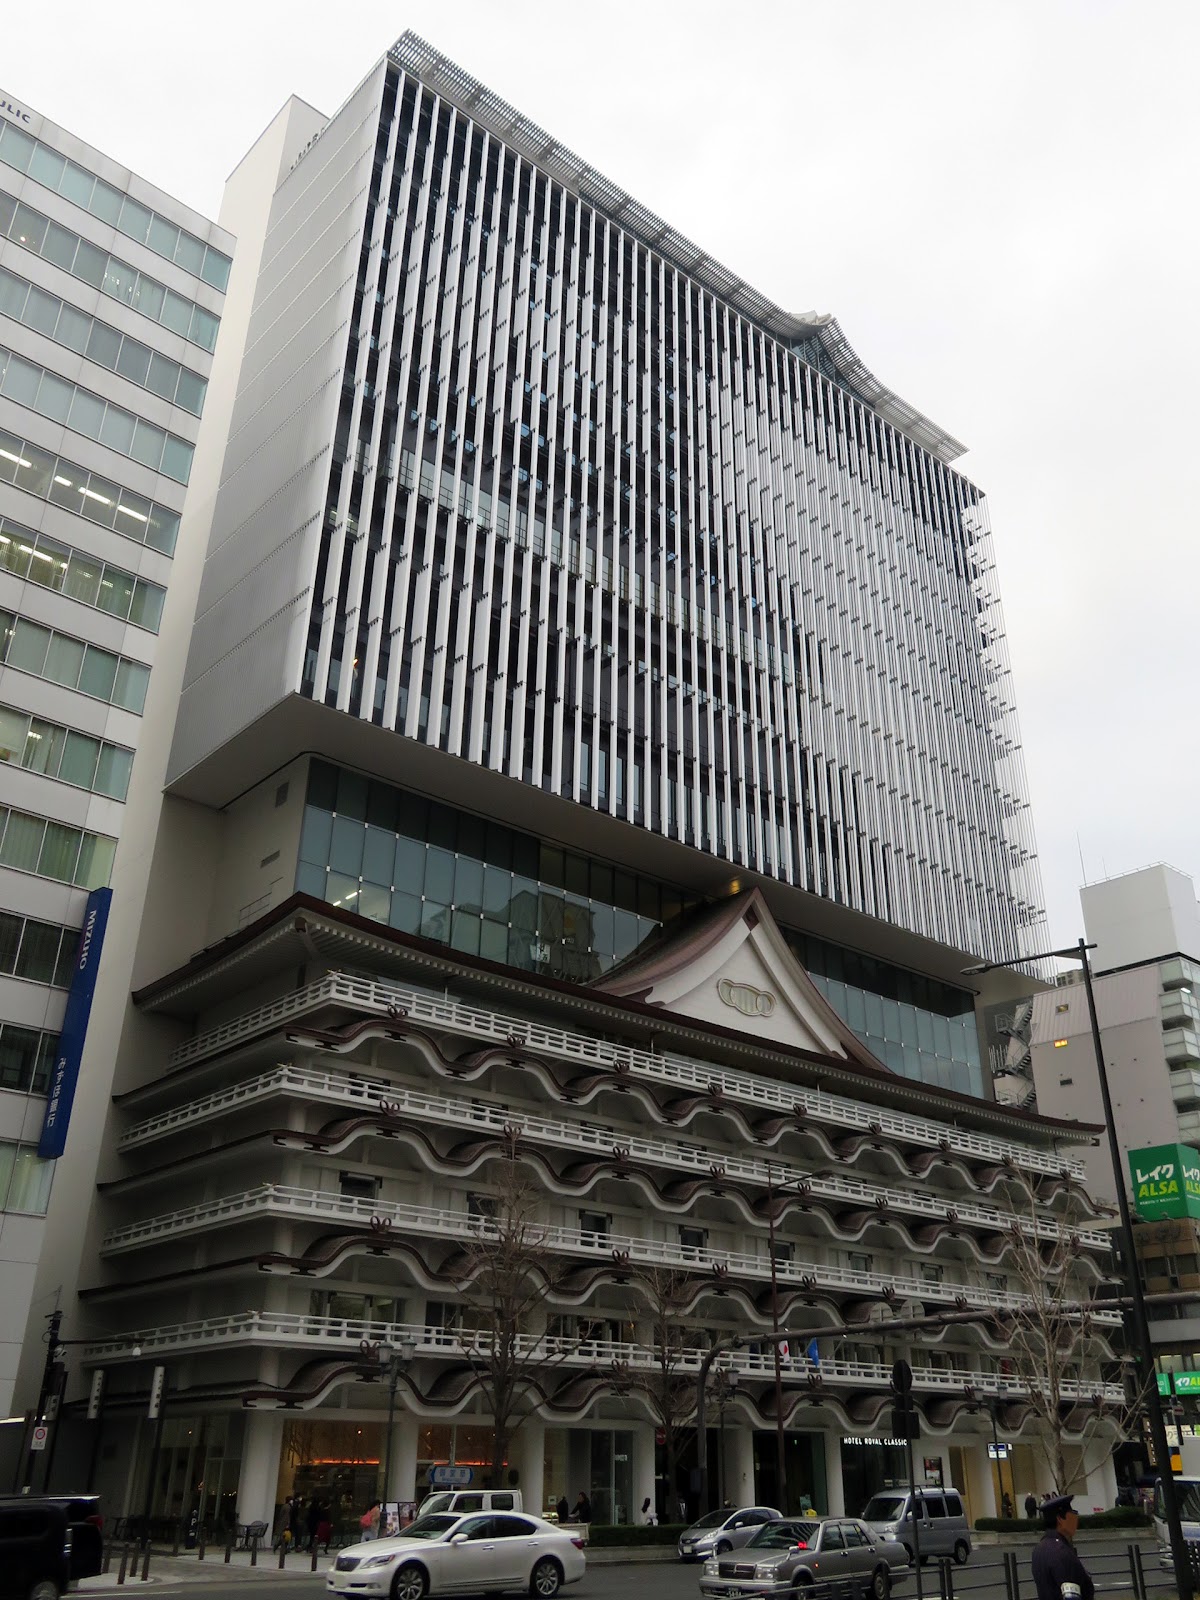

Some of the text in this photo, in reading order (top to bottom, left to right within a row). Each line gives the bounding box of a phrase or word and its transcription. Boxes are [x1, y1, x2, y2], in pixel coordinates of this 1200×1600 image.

[79, 909, 97, 970] MIZUHO
[47, 1057, 66, 1128] みずほ銀行
[1136, 1164, 1174, 1183] レイク
[1182, 1164, 1200, 1181] レイク
[1139, 1180, 1178, 1198] ALSA
[1186, 1179, 1200, 1194] ALS
[843, 1437, 907, 1447] HOTEL ROYAL CLASSIC
